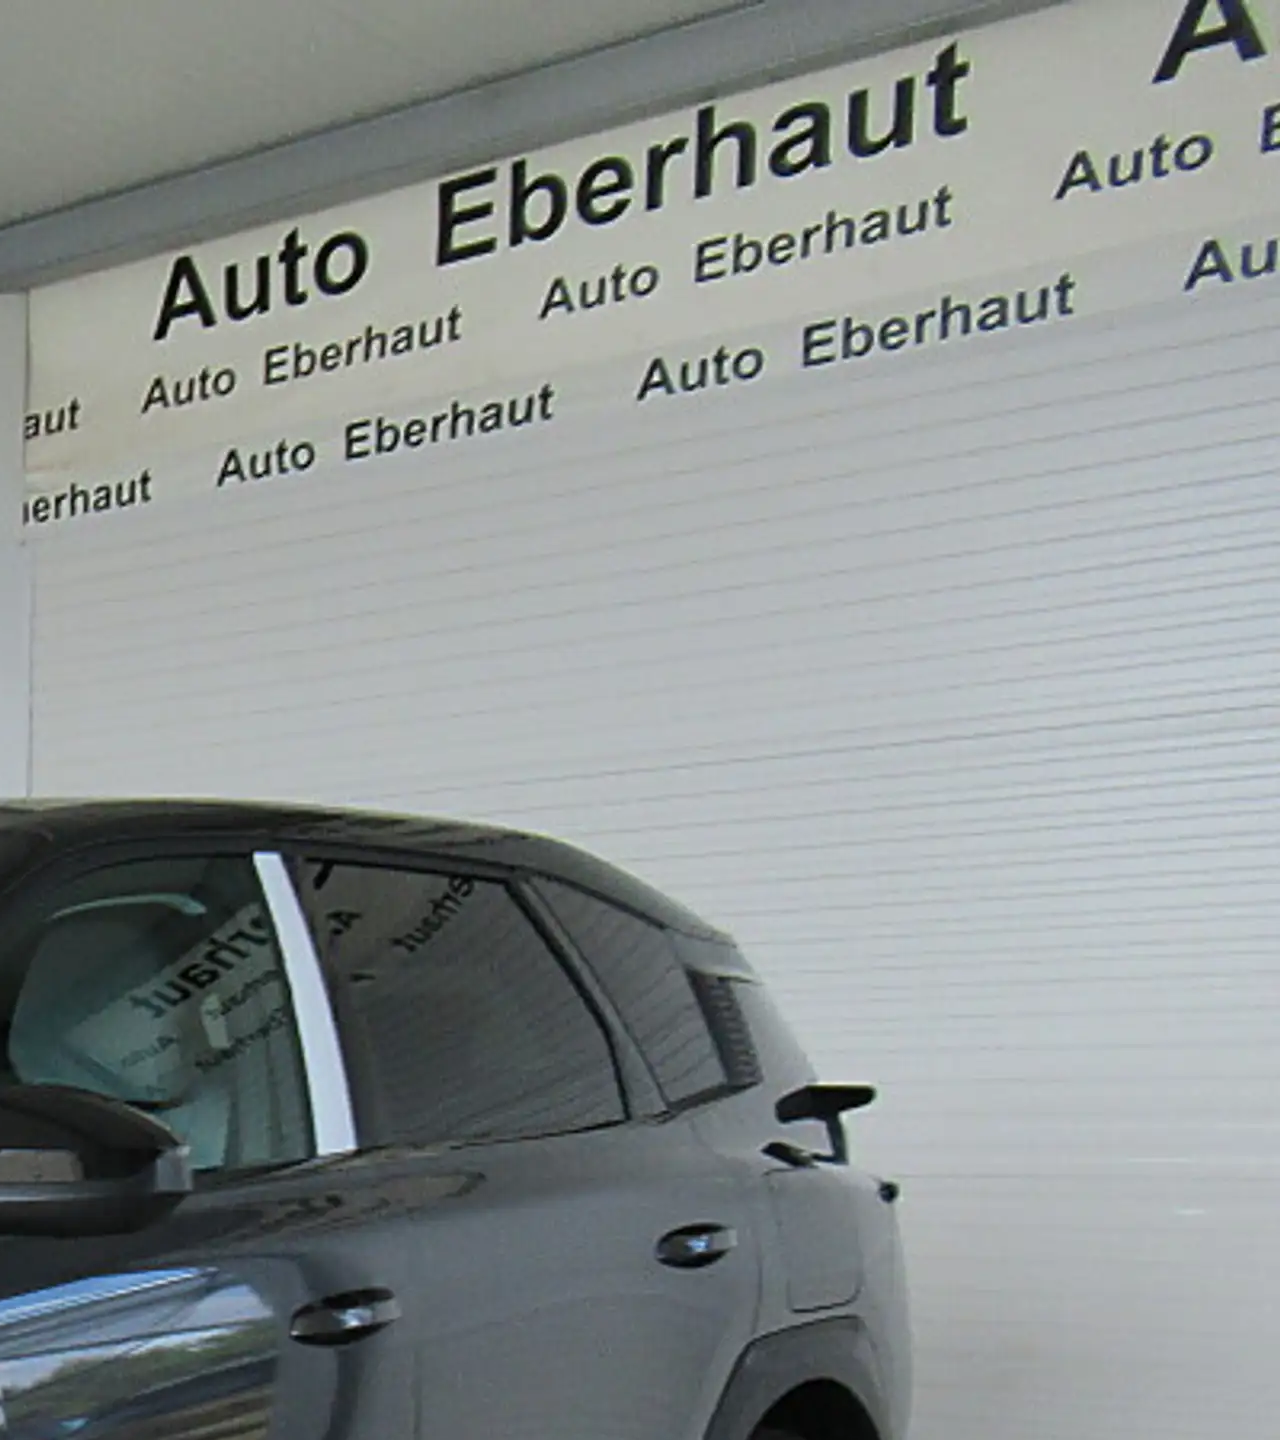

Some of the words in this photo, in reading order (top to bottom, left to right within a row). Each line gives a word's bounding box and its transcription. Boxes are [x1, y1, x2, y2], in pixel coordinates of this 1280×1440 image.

[153, 228, 369, 342] Auto
[435, 42, 970, 267] Eberhaut
[1054, 134, 1214, 201] Auto
[539, 264, 660, 320] Auto
[693, 186, 953, 284] Eberhaut
[141, 367, 237, 414] Auto
[262, 304, 463, 386] Eberhaut
[636, 345, 765, 401] Auto
[802, 273, 1076, 368] Eberhaut
[216, 438, 316, 488] Auto
[345, 383, 554, 461] Eberhaut
